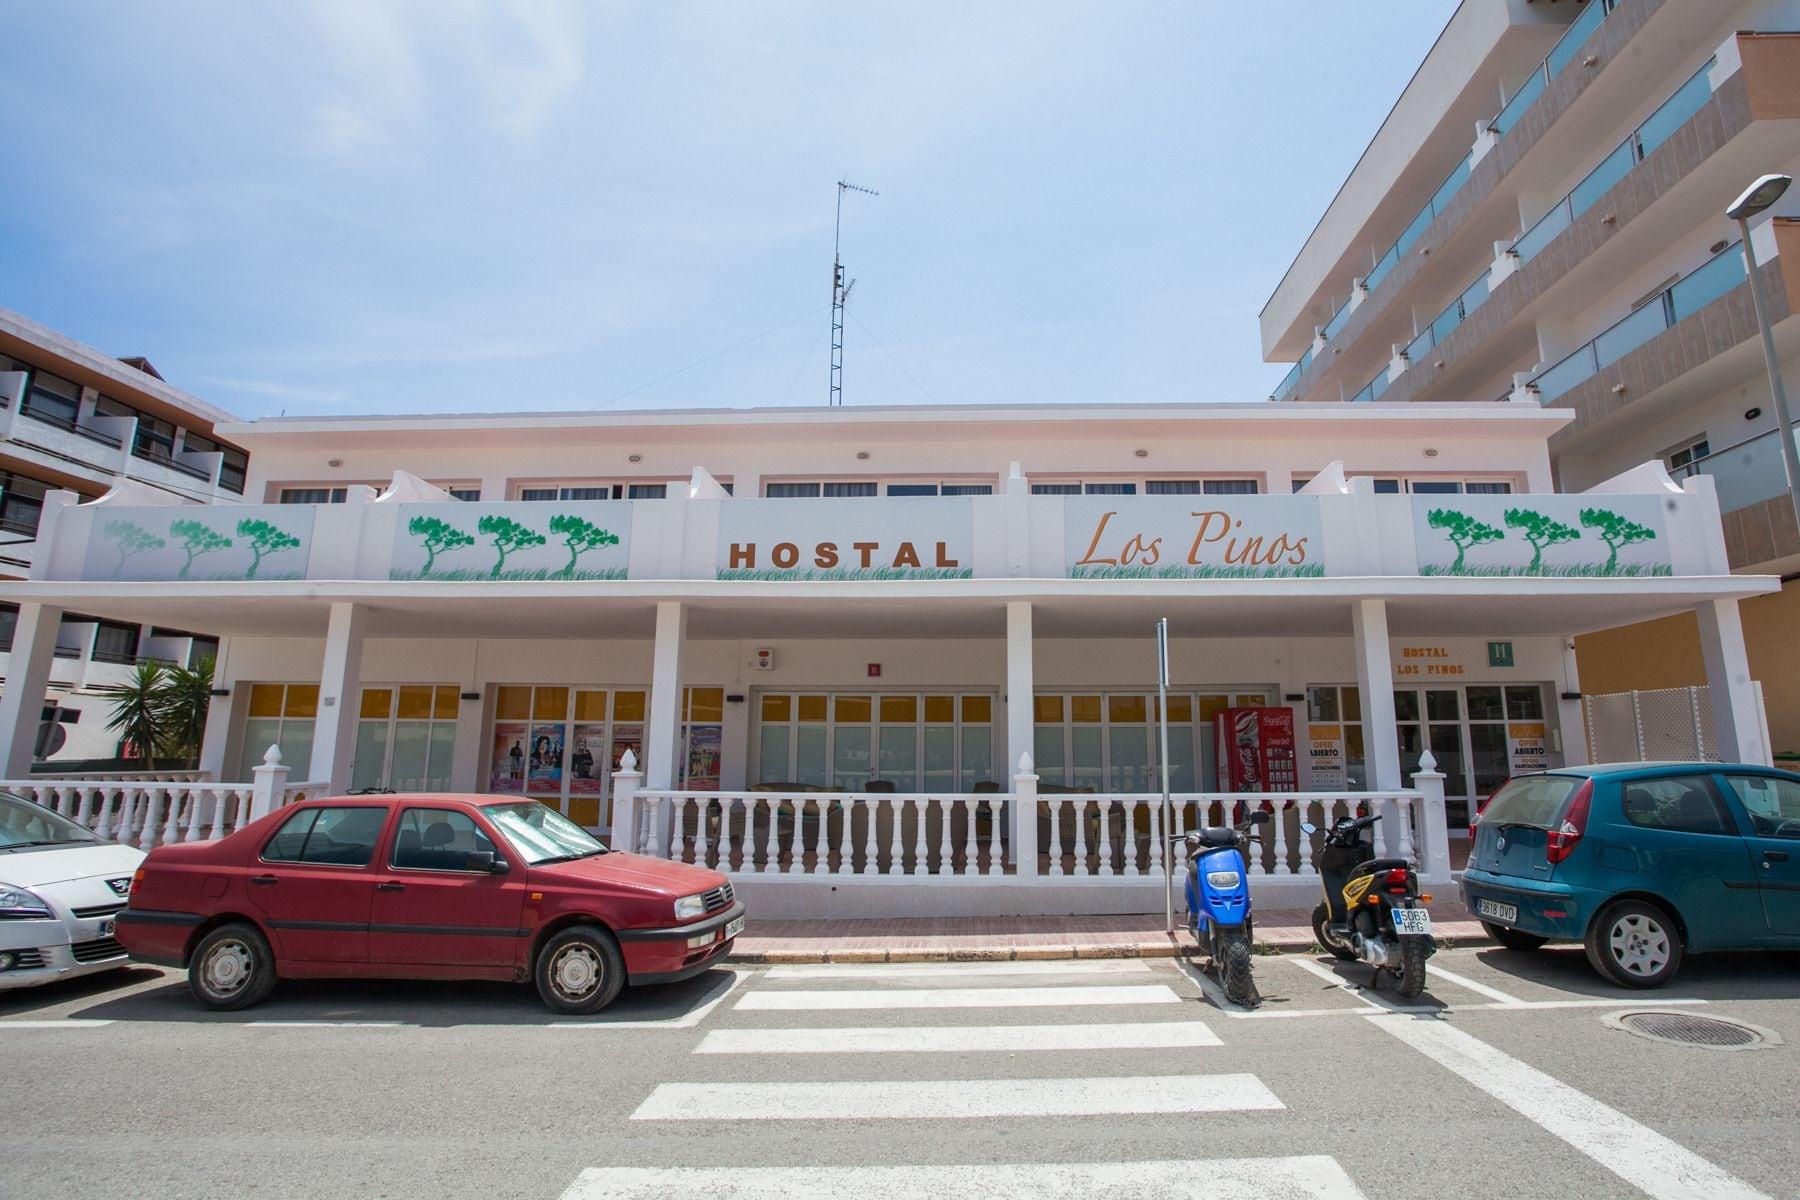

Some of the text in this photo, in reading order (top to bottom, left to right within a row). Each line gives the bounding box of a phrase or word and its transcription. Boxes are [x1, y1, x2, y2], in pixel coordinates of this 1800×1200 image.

[1076, 511, 1308, 566] Los Pinos
[729, 542, 958, 568] HOSTAL
[1403, 647, 1448, 657] HOSTAL
[1495, 644, 1507, 658] H
[1397, 664, 1464, 674] LOS PINOS
[1515, 747, 1544, 755] ABIERTO
[1401, 910, 1427, 921] 5063
[1482, 900, 1514, 920] 3618 DVD
[1404, 921, 1424, 932] HFG
